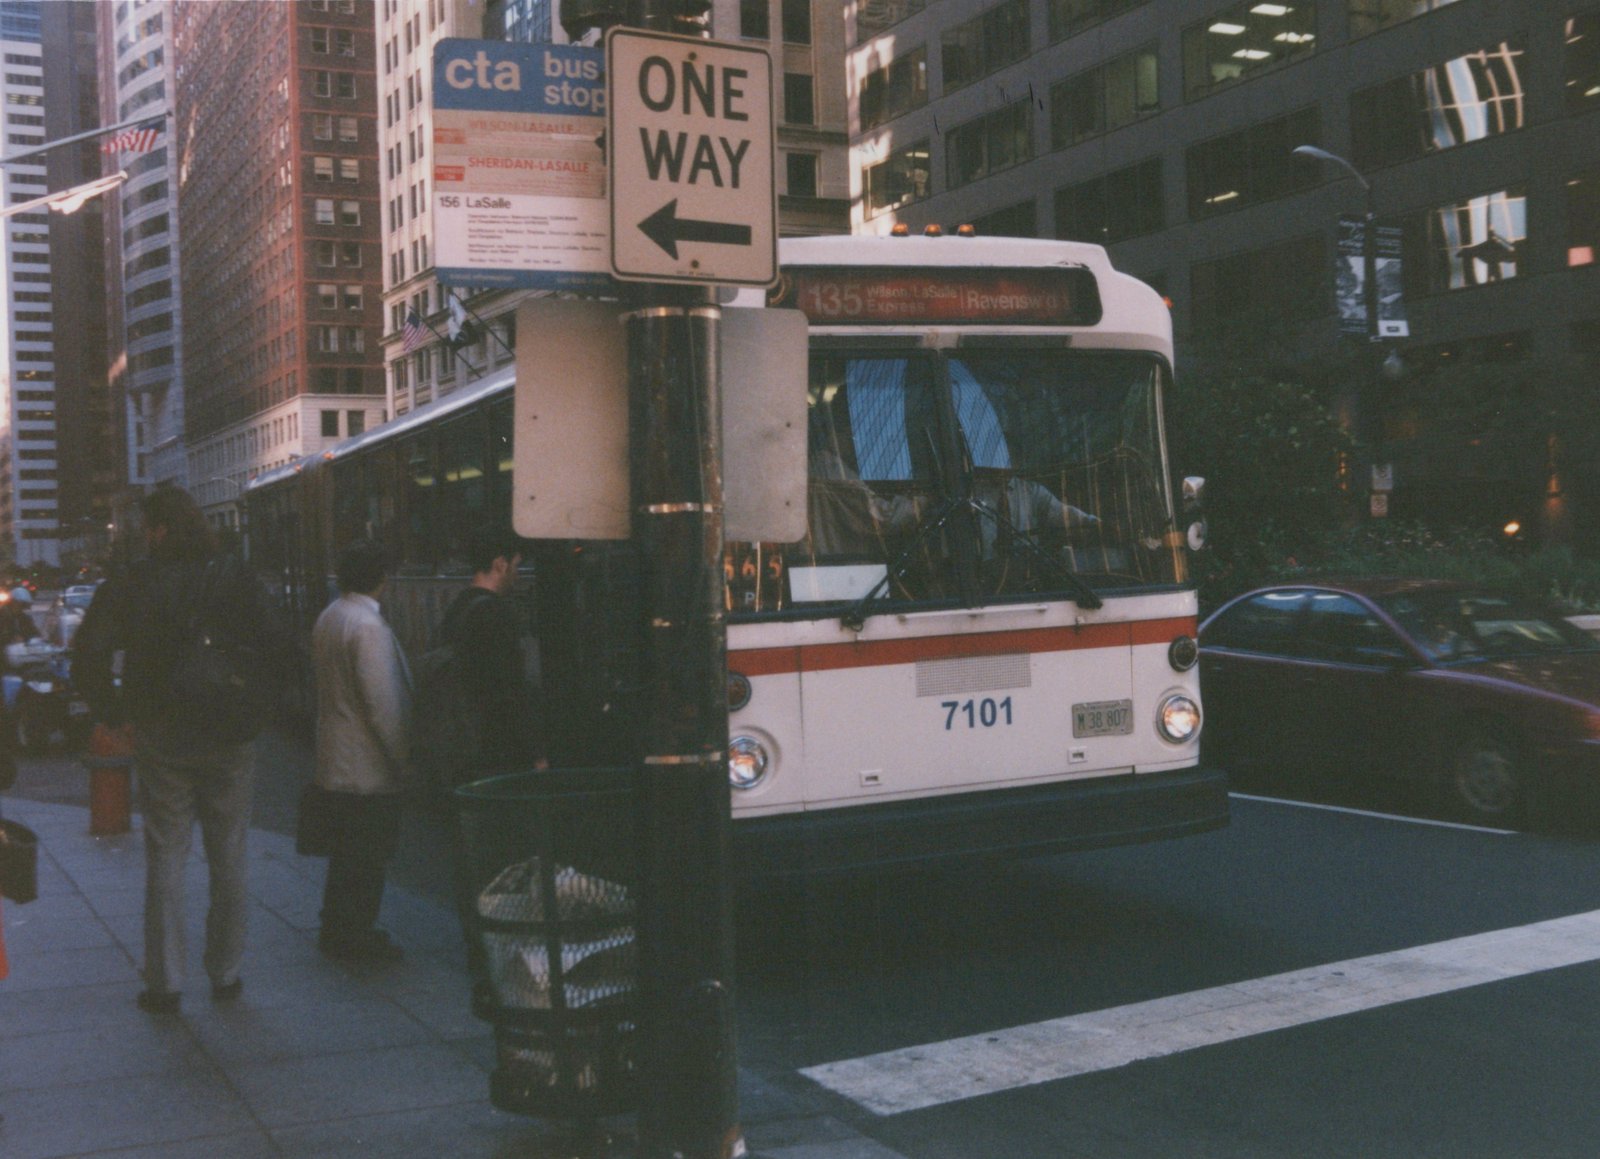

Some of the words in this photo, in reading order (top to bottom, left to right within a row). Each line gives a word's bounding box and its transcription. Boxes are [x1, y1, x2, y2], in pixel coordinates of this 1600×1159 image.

[445, 51, 521, 91] cta
[544, 51, 598, 80] bus
[544, 81, 606, 112] stop
[638, 55, 748, 121] ONE
[468, 157, 589, 173] SHERIDAN-LASALLE
[639, 127, 750, 189] WAY
[439, 196, 460, 209] 156
[466, 196, 512, 210] LaSalle
[808, 282, 863, 316] 135
[942, 696, 1012, 730] 7101
[1077, 713, 1086, 730] M
[1106, 708, 1128, 727] 807
